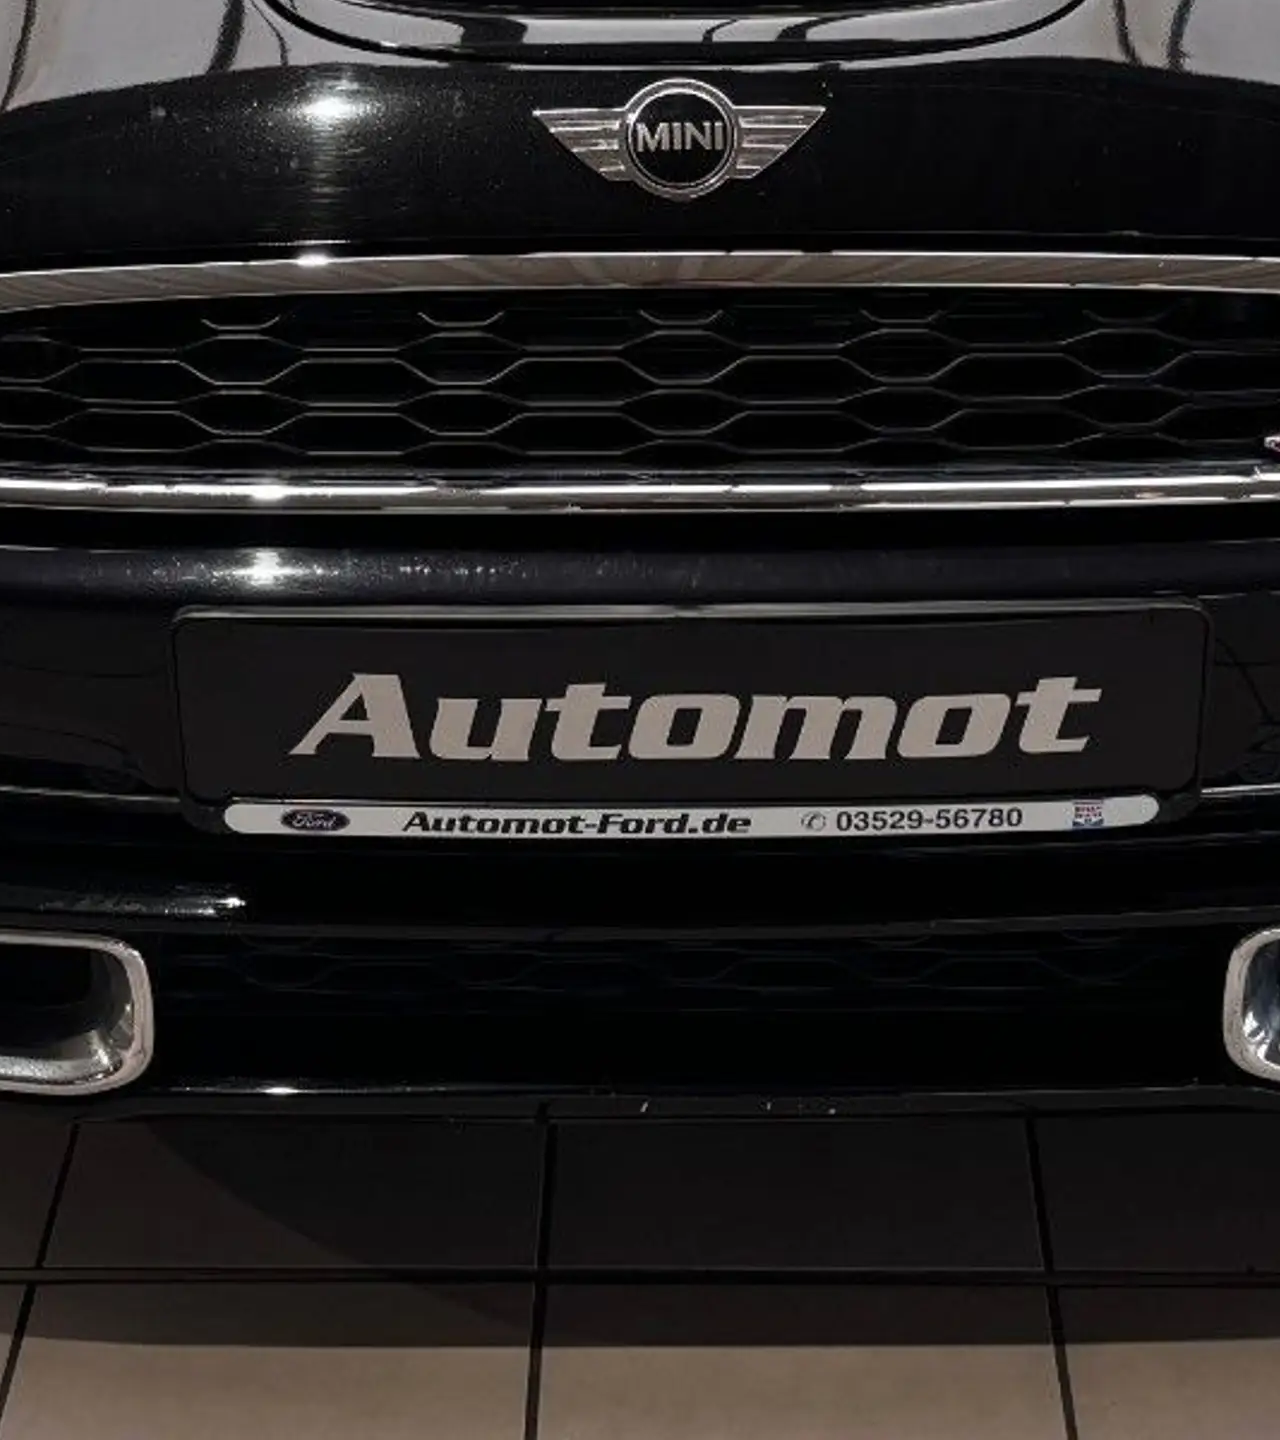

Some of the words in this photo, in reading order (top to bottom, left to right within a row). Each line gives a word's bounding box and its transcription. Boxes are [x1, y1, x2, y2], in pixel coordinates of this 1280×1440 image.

[635, 121, 724, 152] MINI
[288, 672, 1102, 761] Automot
[402, 810, 752, 835] Automot-Ford.de
[836, 808, 1023, 831] 03529-56780
